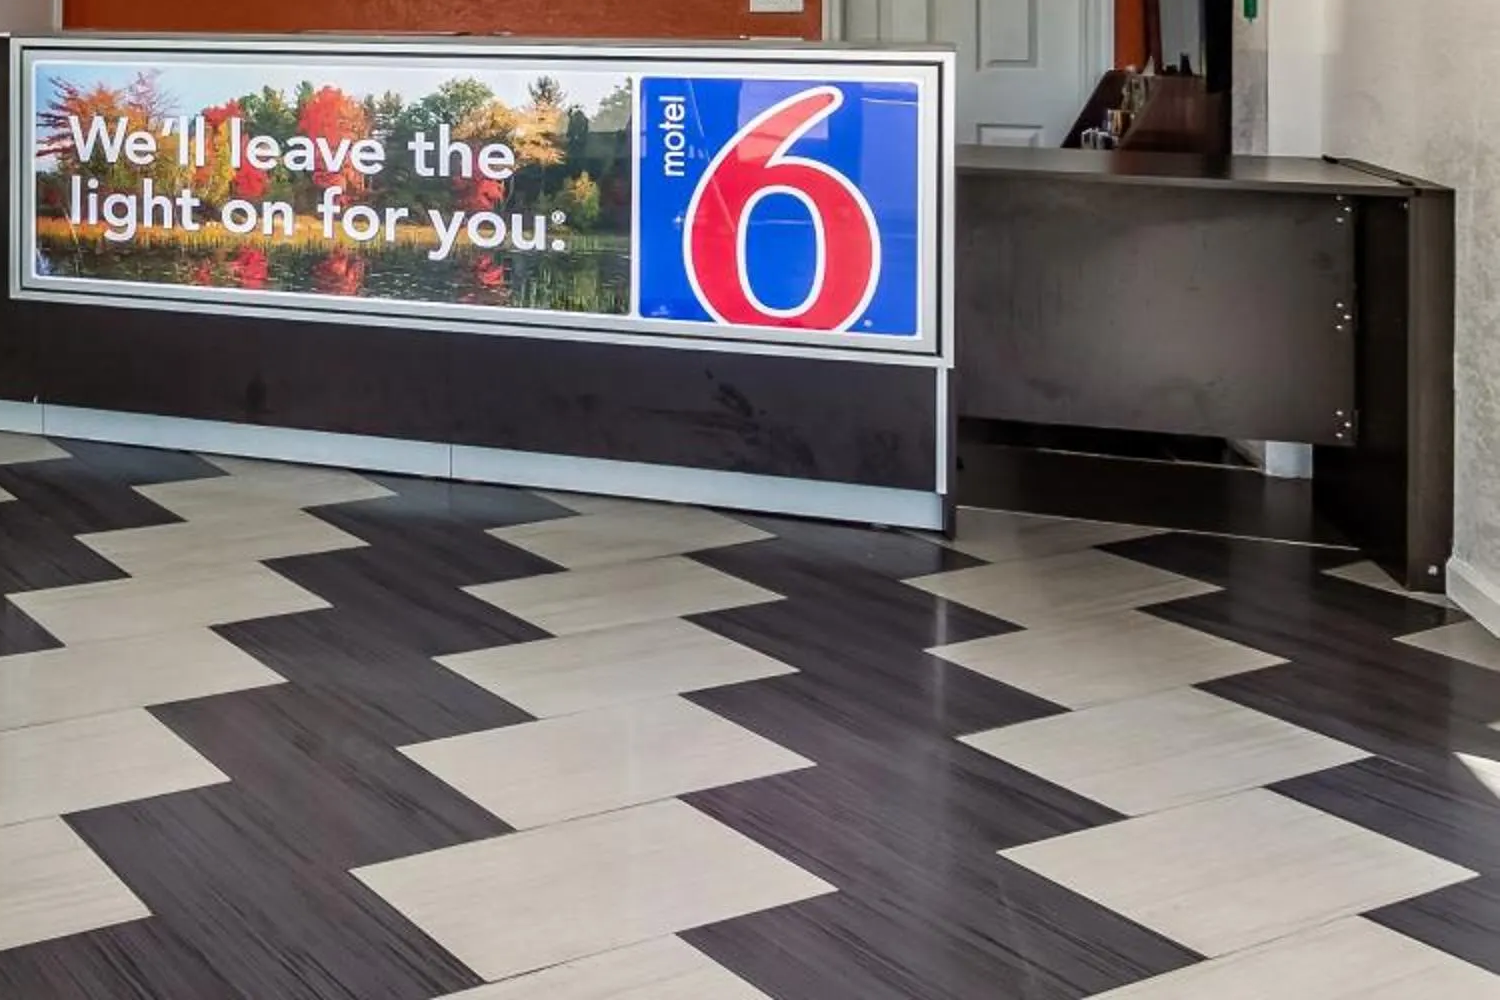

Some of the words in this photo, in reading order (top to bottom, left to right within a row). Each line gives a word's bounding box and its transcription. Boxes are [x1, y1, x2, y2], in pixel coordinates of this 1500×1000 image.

[67, 114, 206, 168] We'll
[230, 116, 386, 175] leave
[407, 123, 516, 180] the
[70, 175, 200, 243] light
[220, 198, 294, 237] on
[316, 185, 410, 242] for
[657, 95, 686, 178] motel
[682, 85, 882, 333] 6
